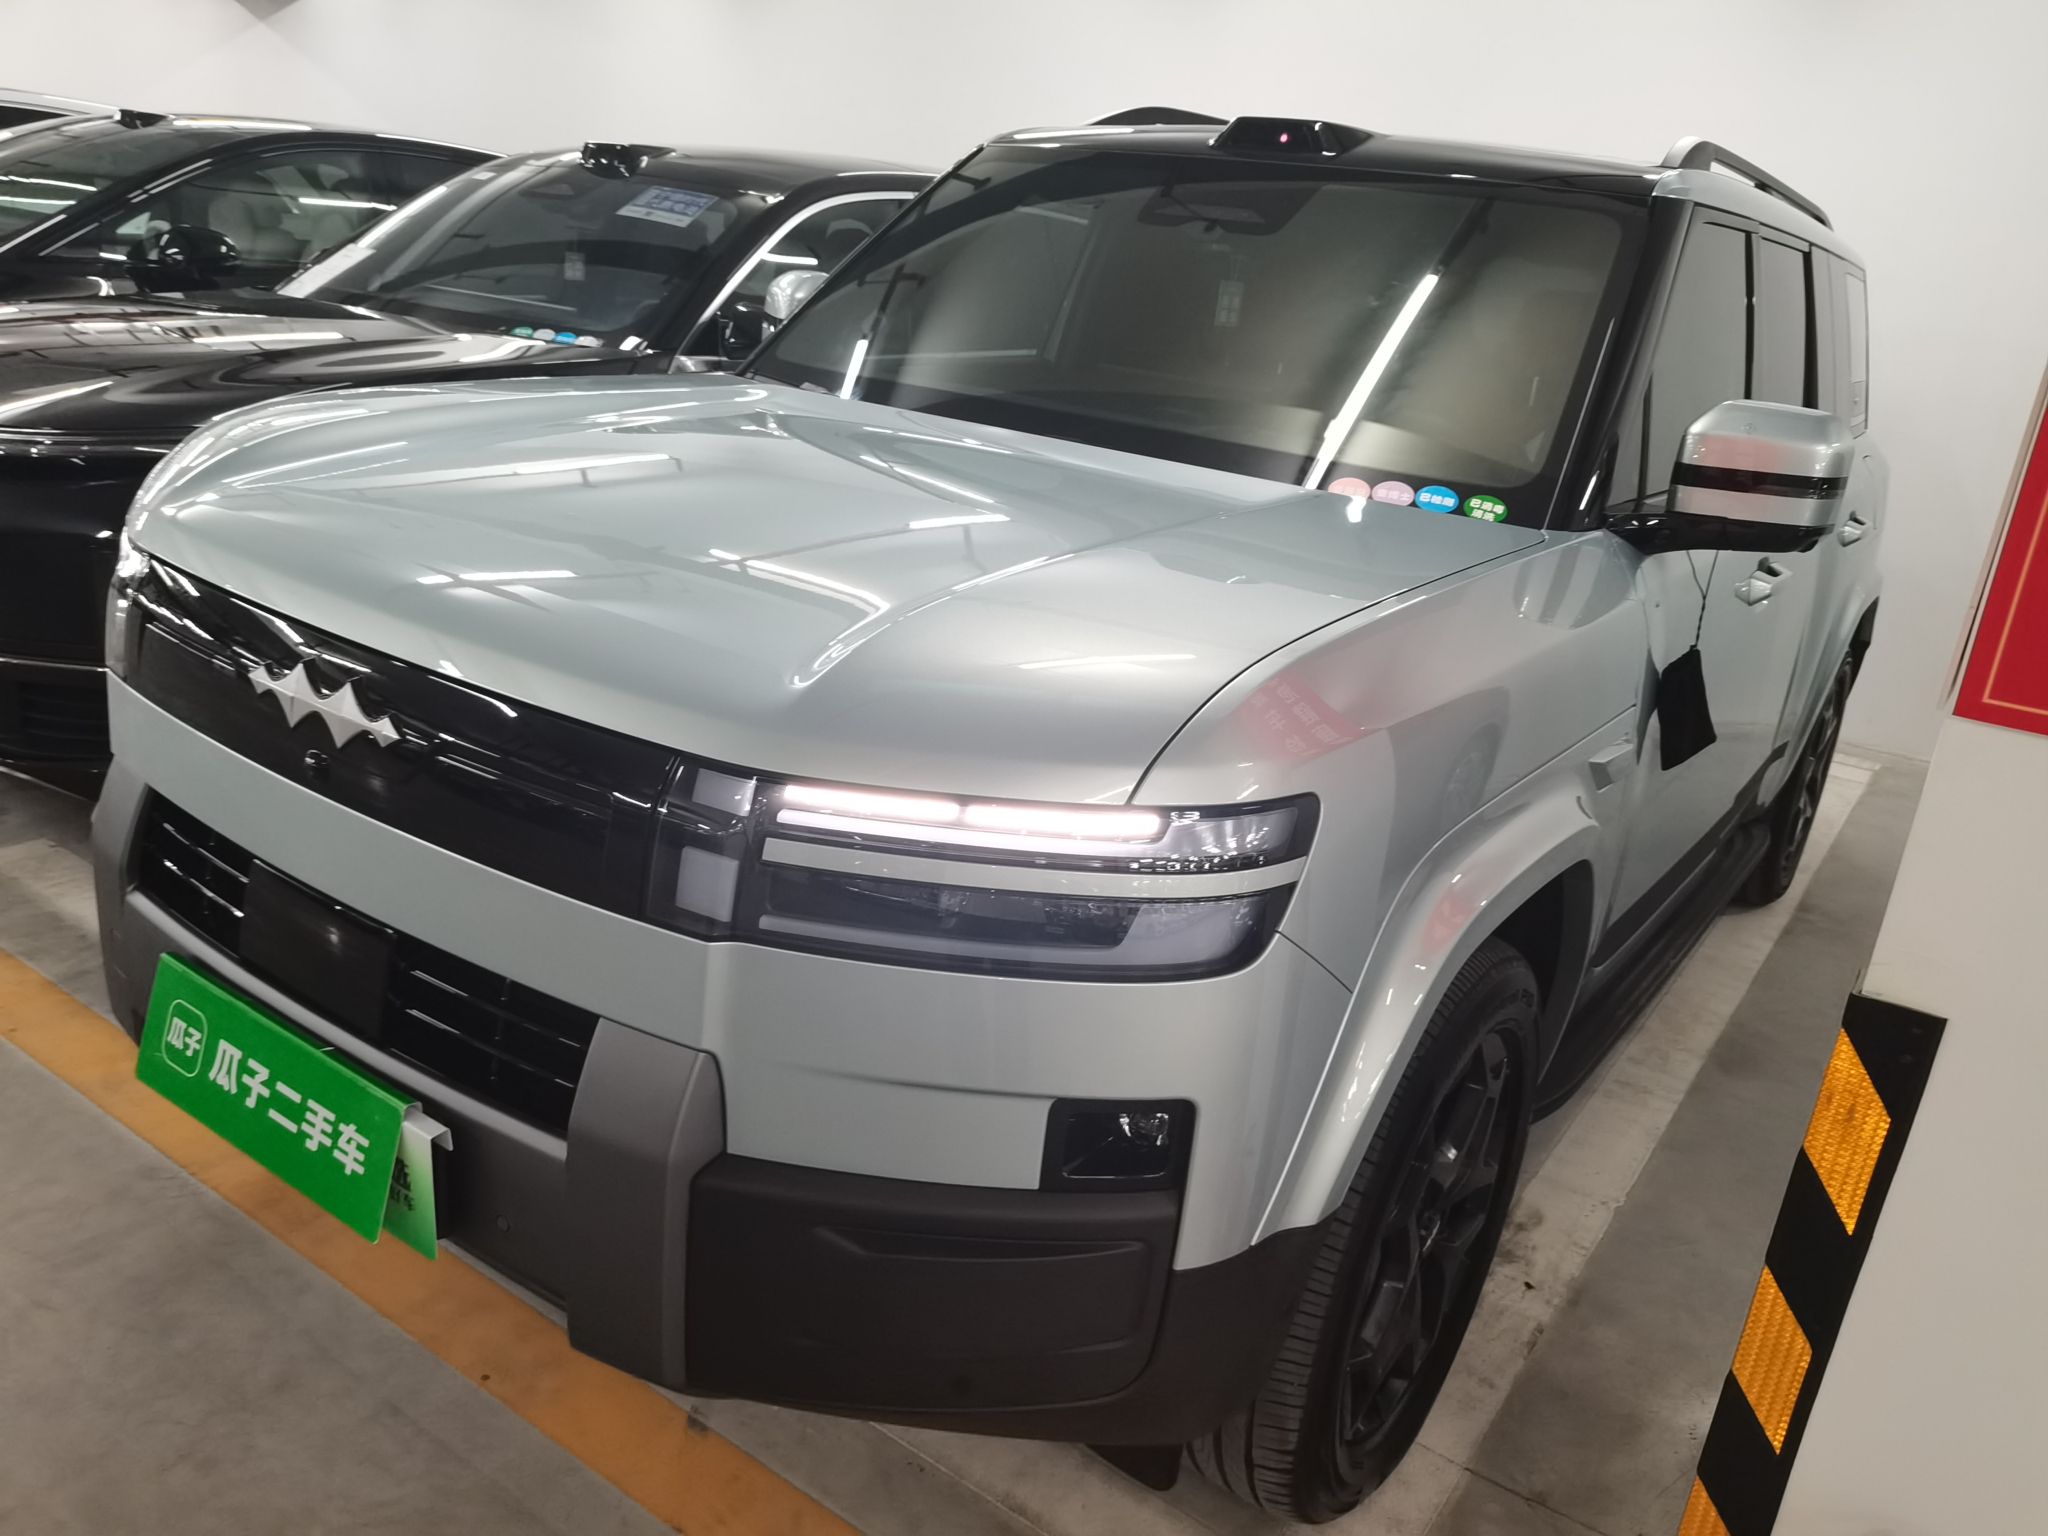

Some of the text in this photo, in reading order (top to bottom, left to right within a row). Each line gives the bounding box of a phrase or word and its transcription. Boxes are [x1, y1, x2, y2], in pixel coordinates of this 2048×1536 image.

[167, 1016, 203, 1057] 瓜子
[208, 1039, 371, 1176] 瓜子二手车
